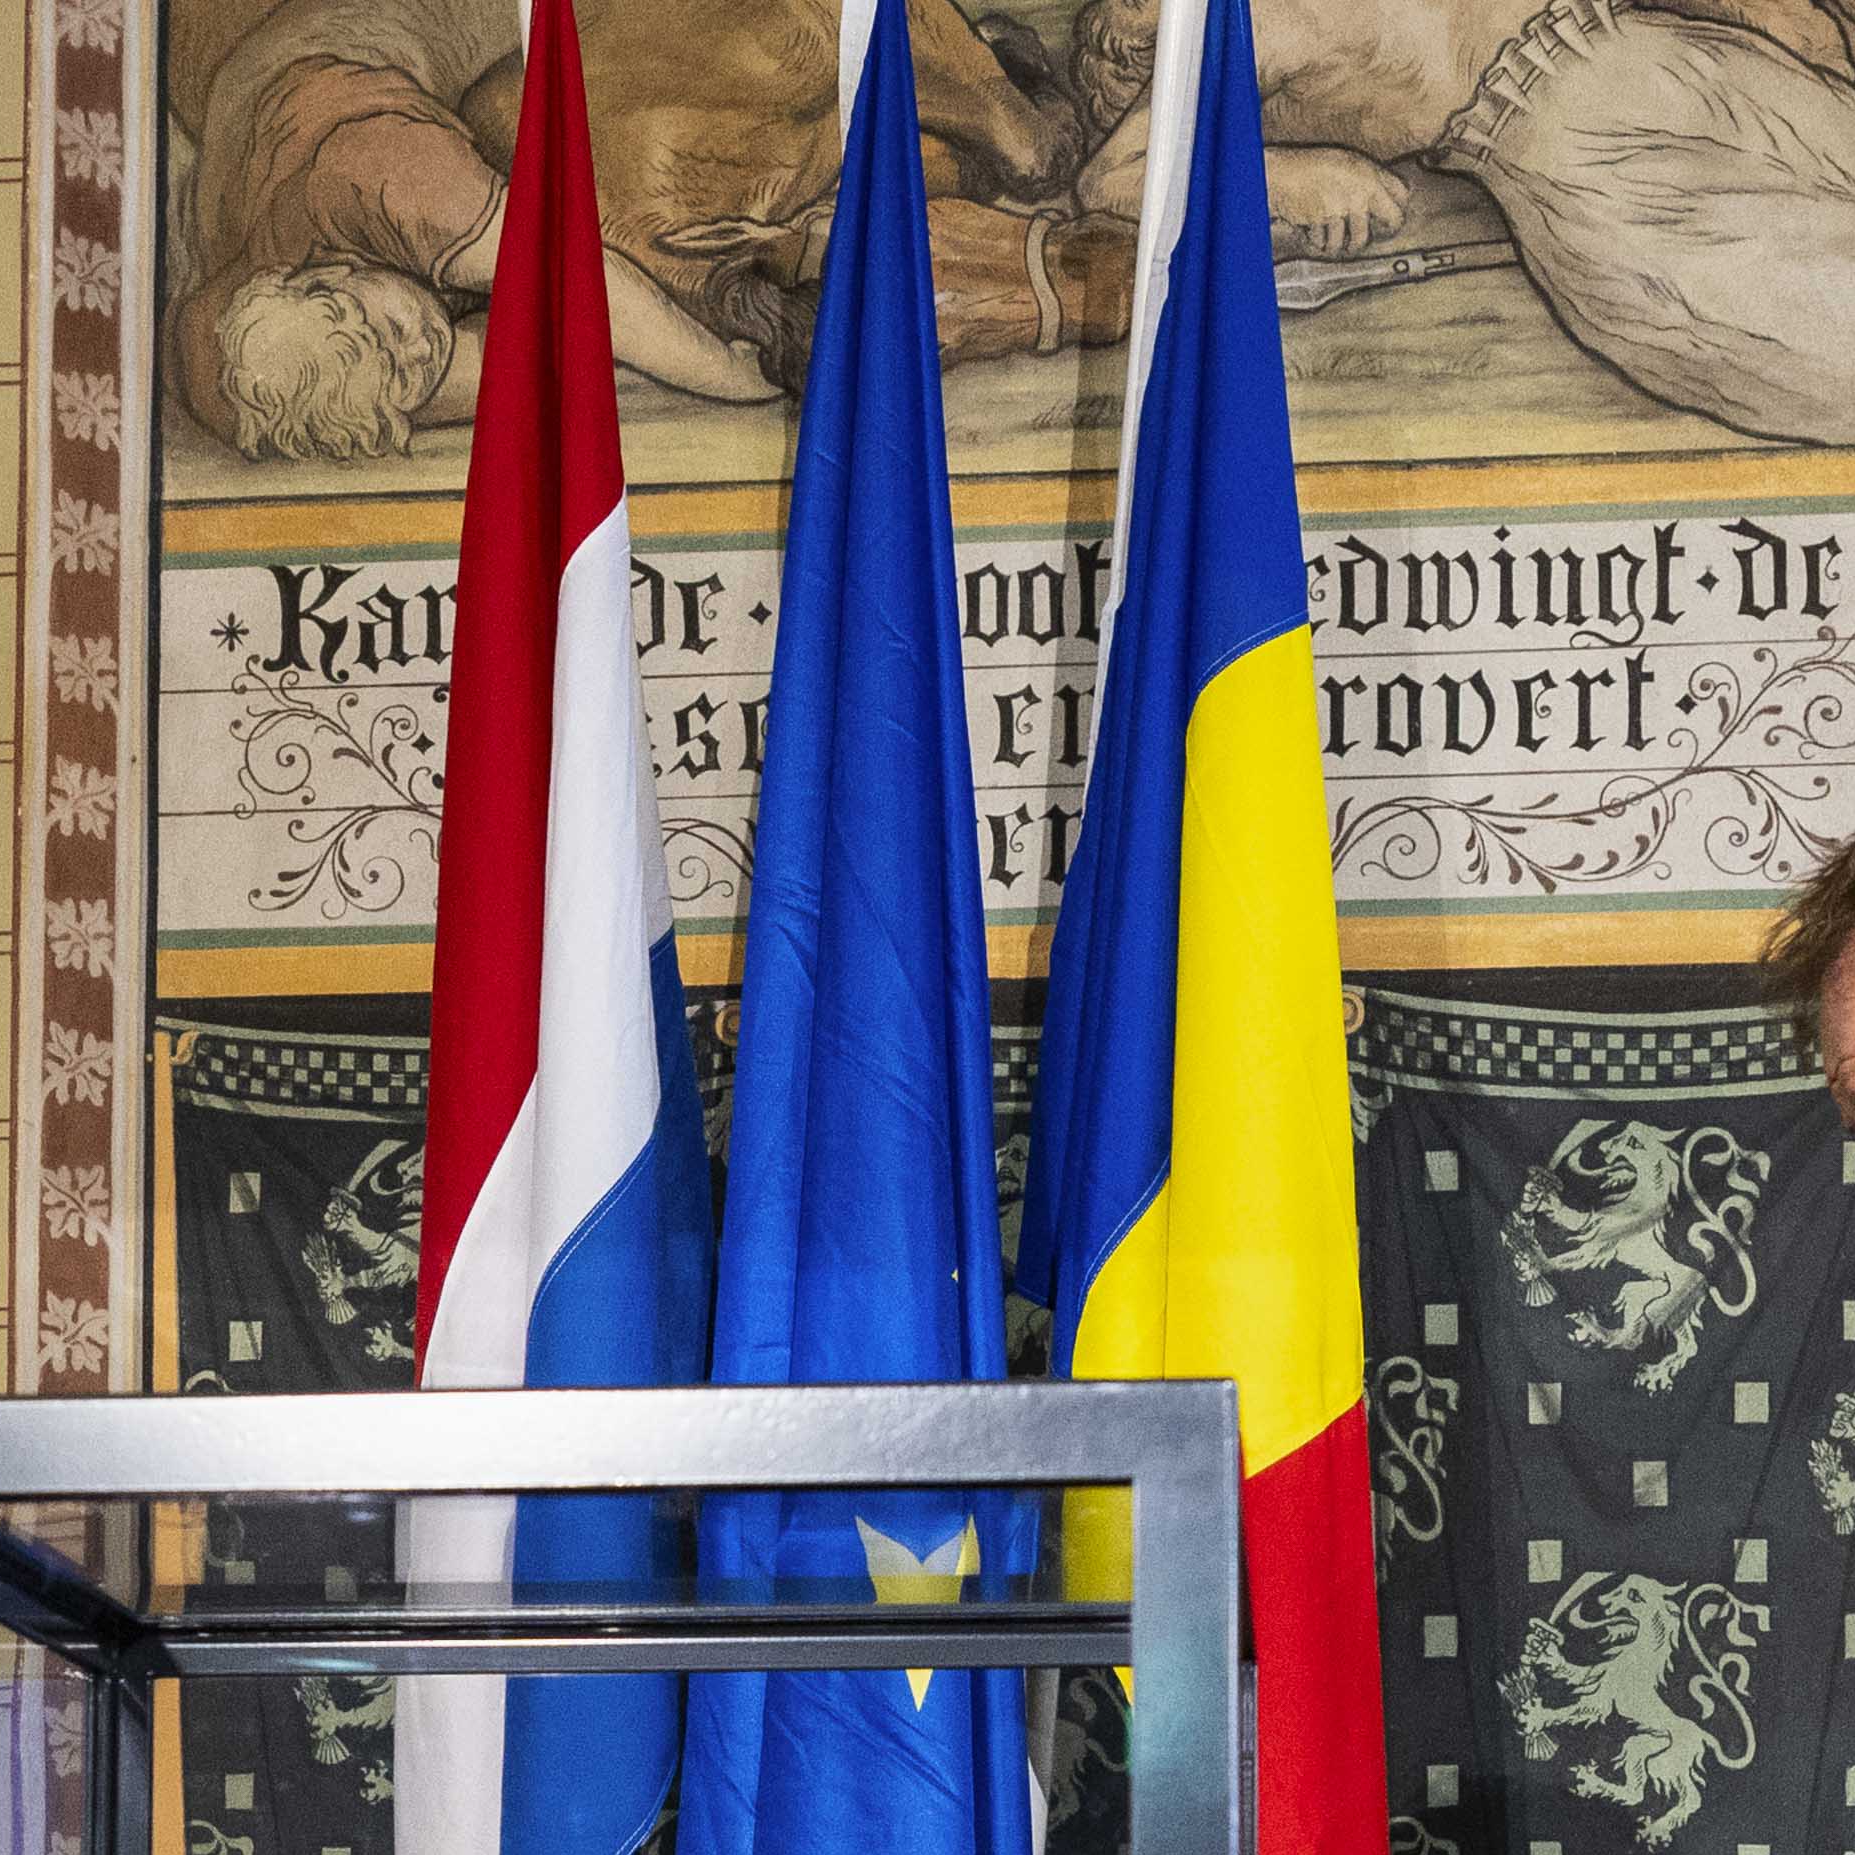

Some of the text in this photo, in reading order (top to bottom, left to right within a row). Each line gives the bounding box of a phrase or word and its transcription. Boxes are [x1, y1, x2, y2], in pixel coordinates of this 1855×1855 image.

[262, 563, 458, 684] Kar
[962, 539, 1113, 648] oot
[1719, 517, 1843, 621] de
[1319, 647, 1656, 758] rovert
